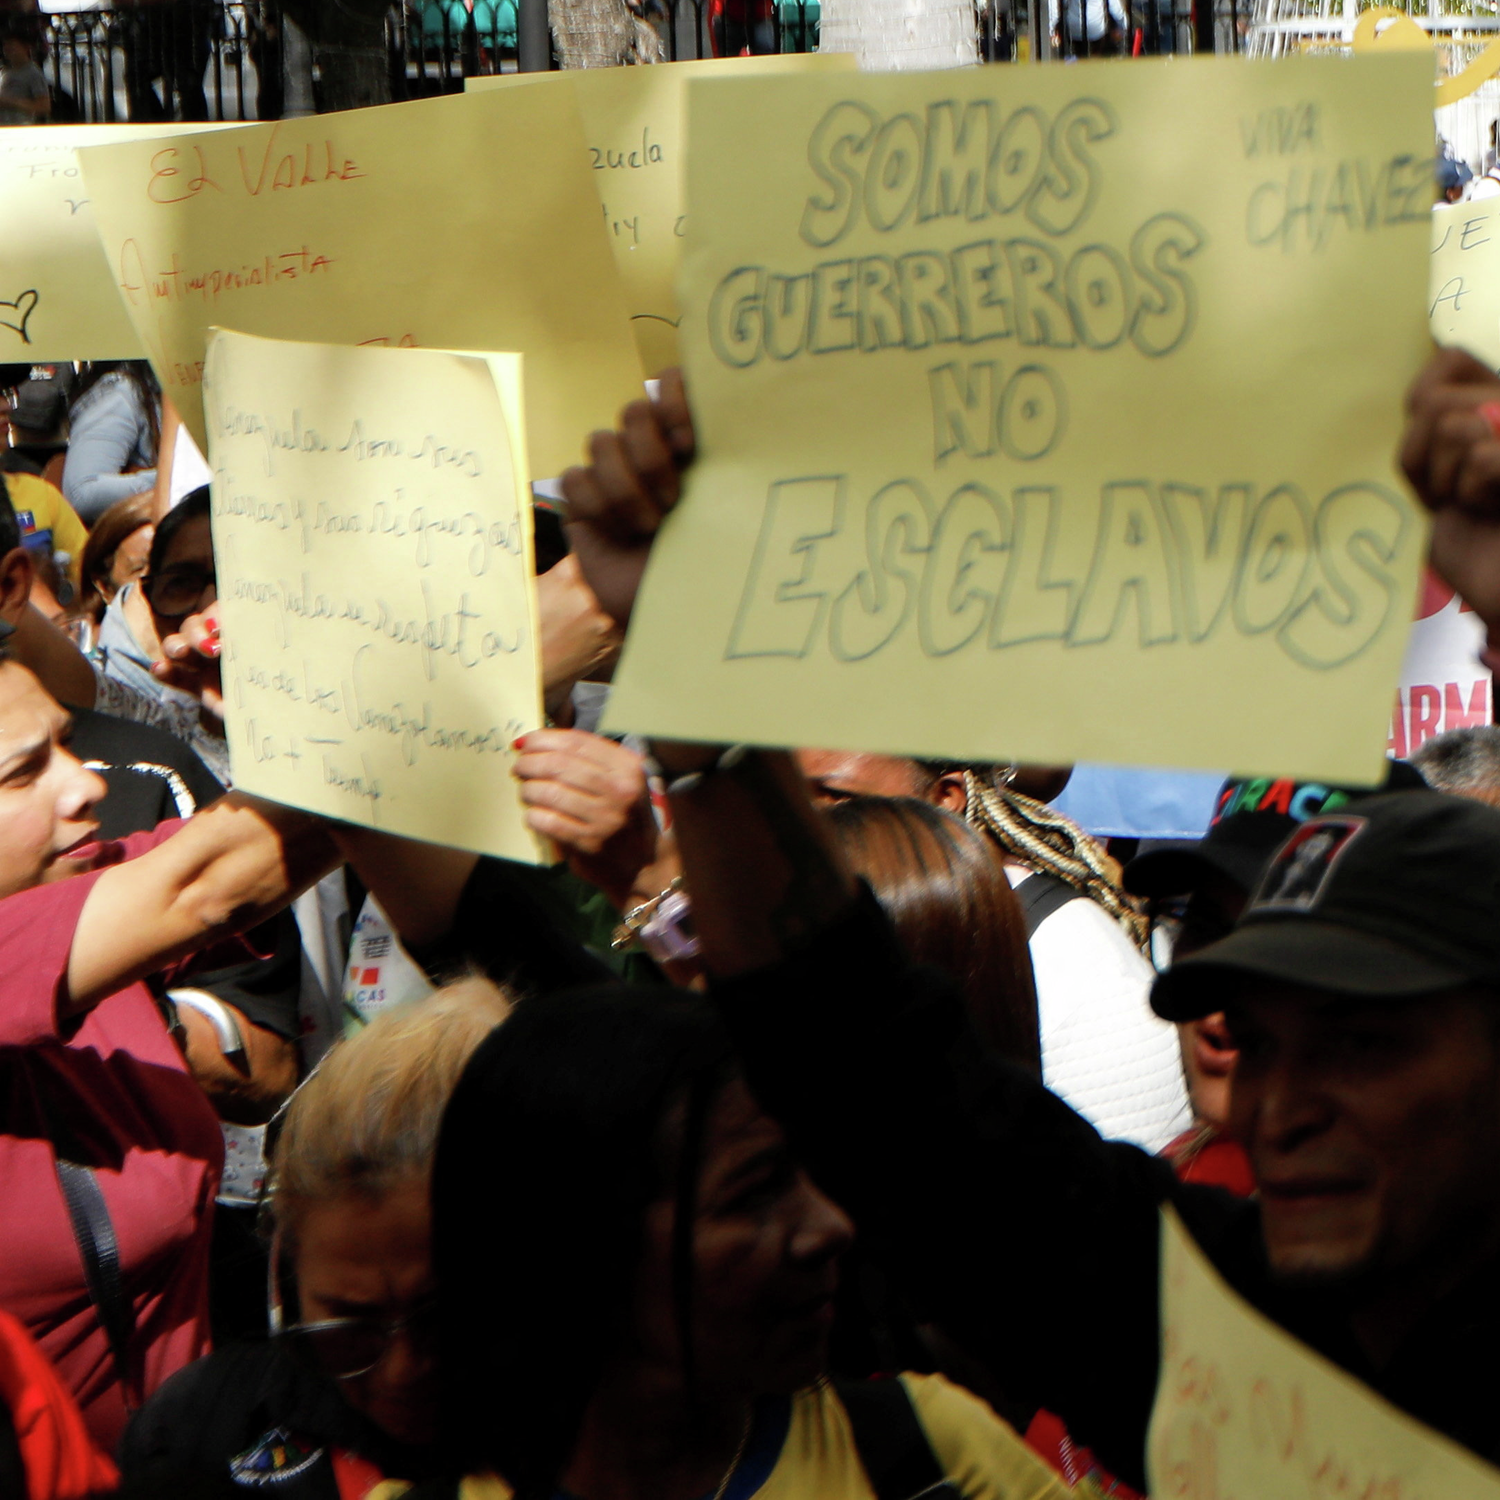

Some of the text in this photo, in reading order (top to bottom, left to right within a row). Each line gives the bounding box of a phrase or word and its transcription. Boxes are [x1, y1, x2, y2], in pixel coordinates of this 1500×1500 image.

[800, 97, 1117, 248] SOMOS
[709, 211, 1205, 368] GUERREROS
[929, 359, 1069, 466] NO
[725, 474, 1430, 671] ESCLAVOS
